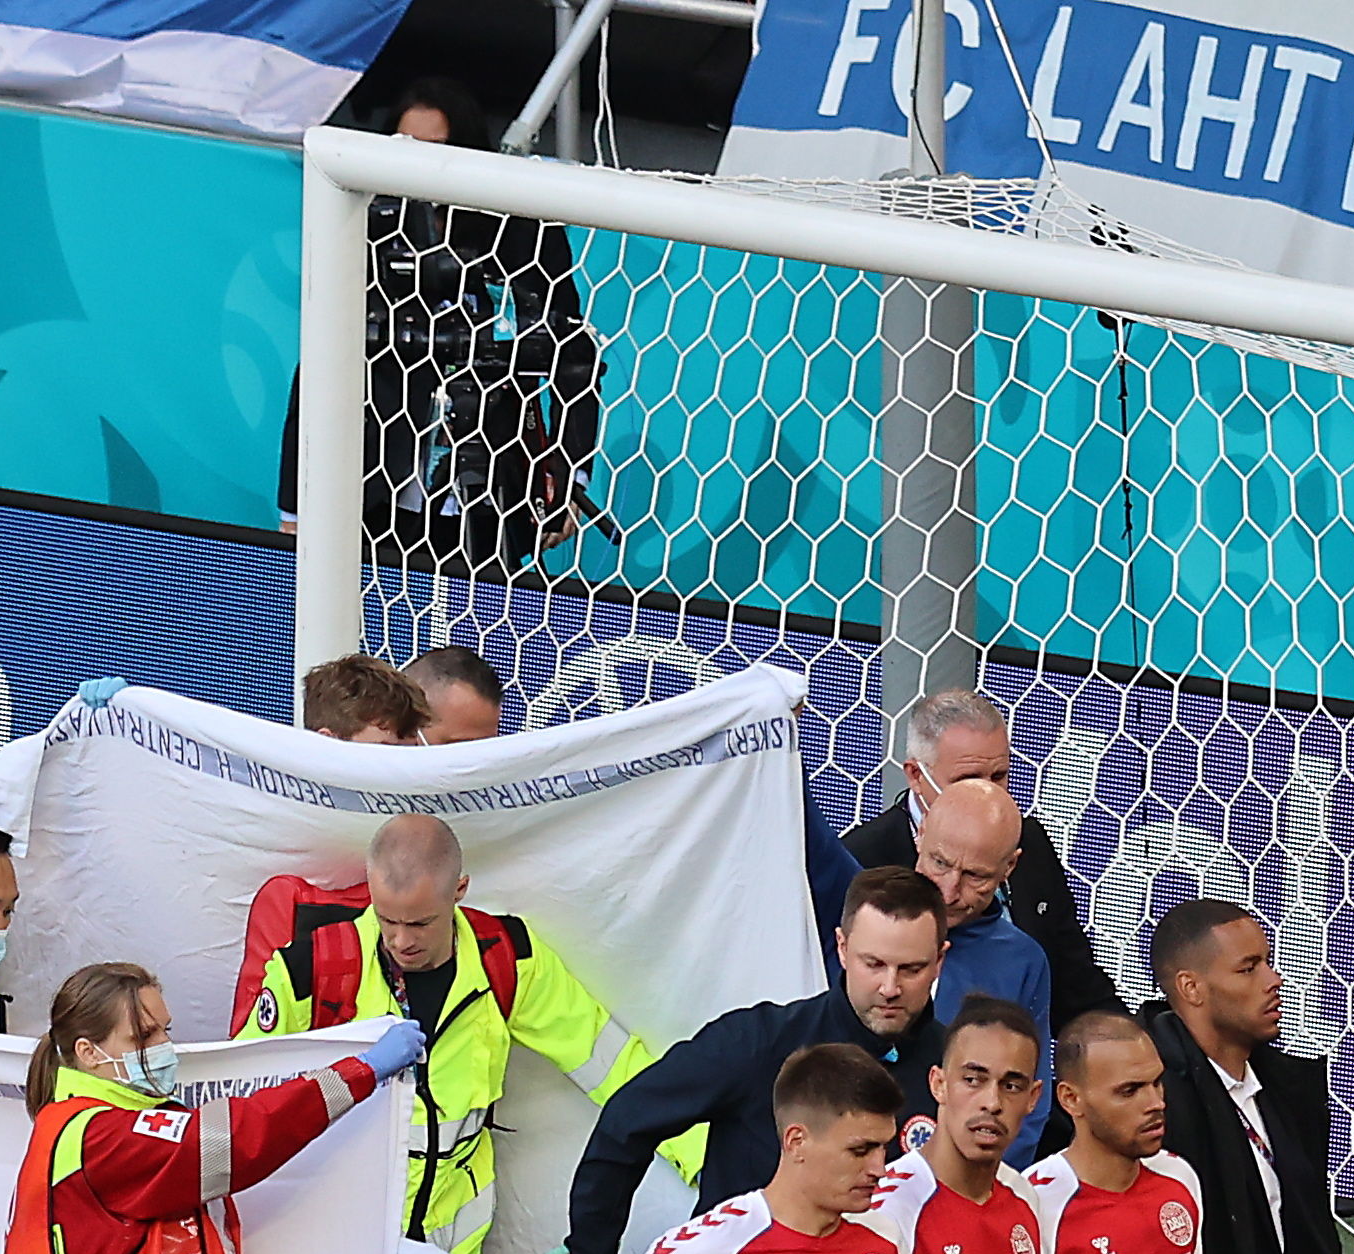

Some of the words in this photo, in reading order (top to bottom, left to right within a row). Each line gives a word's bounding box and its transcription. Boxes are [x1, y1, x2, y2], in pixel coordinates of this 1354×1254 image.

[818, 0, 981, 121] FC
[216, 748, 233, 782] H
[247, 757, 336, 809] REGION
[615, 742, 704, 781] REGION
